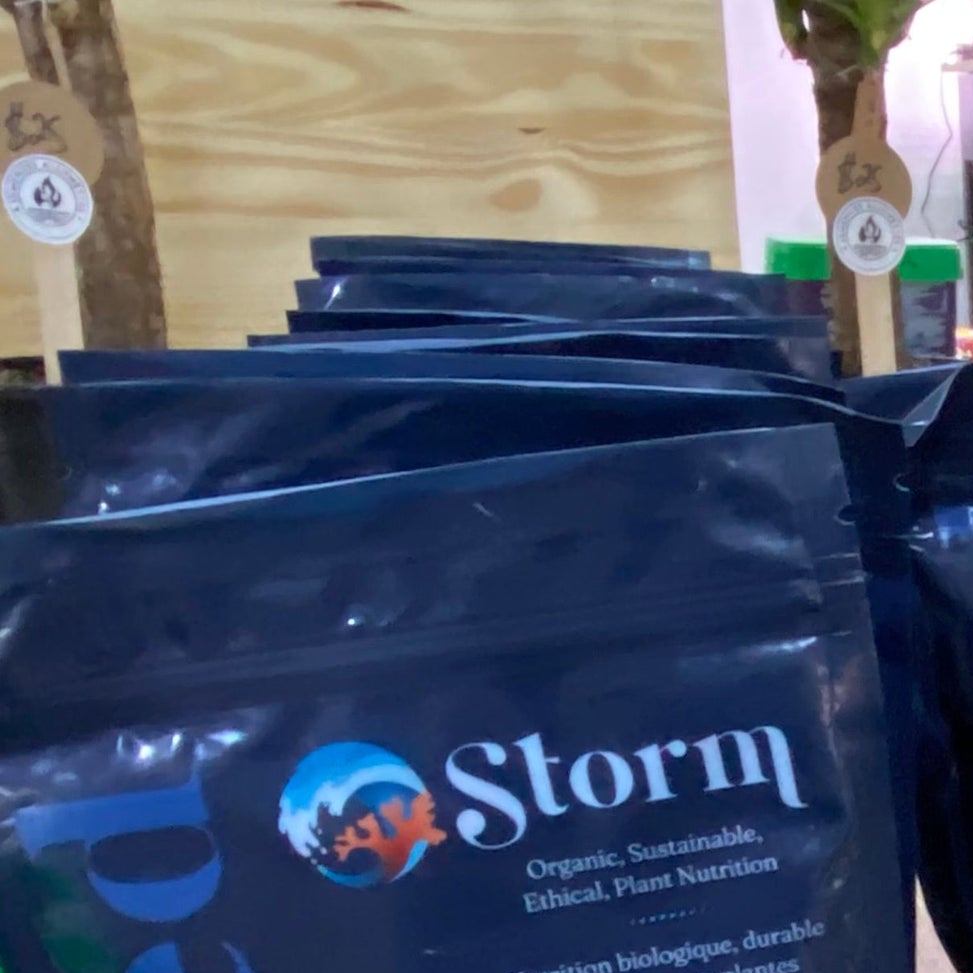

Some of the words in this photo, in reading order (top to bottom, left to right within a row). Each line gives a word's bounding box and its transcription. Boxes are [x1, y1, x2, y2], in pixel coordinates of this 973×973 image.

[445, 724, 808, 852] Storm
[526, 848, 626, 881] Organic,
[627, 824, 764, 862] Sustainable,
[522, 881, 611, 914] Ethical,
[612, 872, 674, 898] Plant
[676, 854, 779, 886] Nutrition
[616, 939, 740, 973] biologique,
[742, 918, 826, 950] durable
